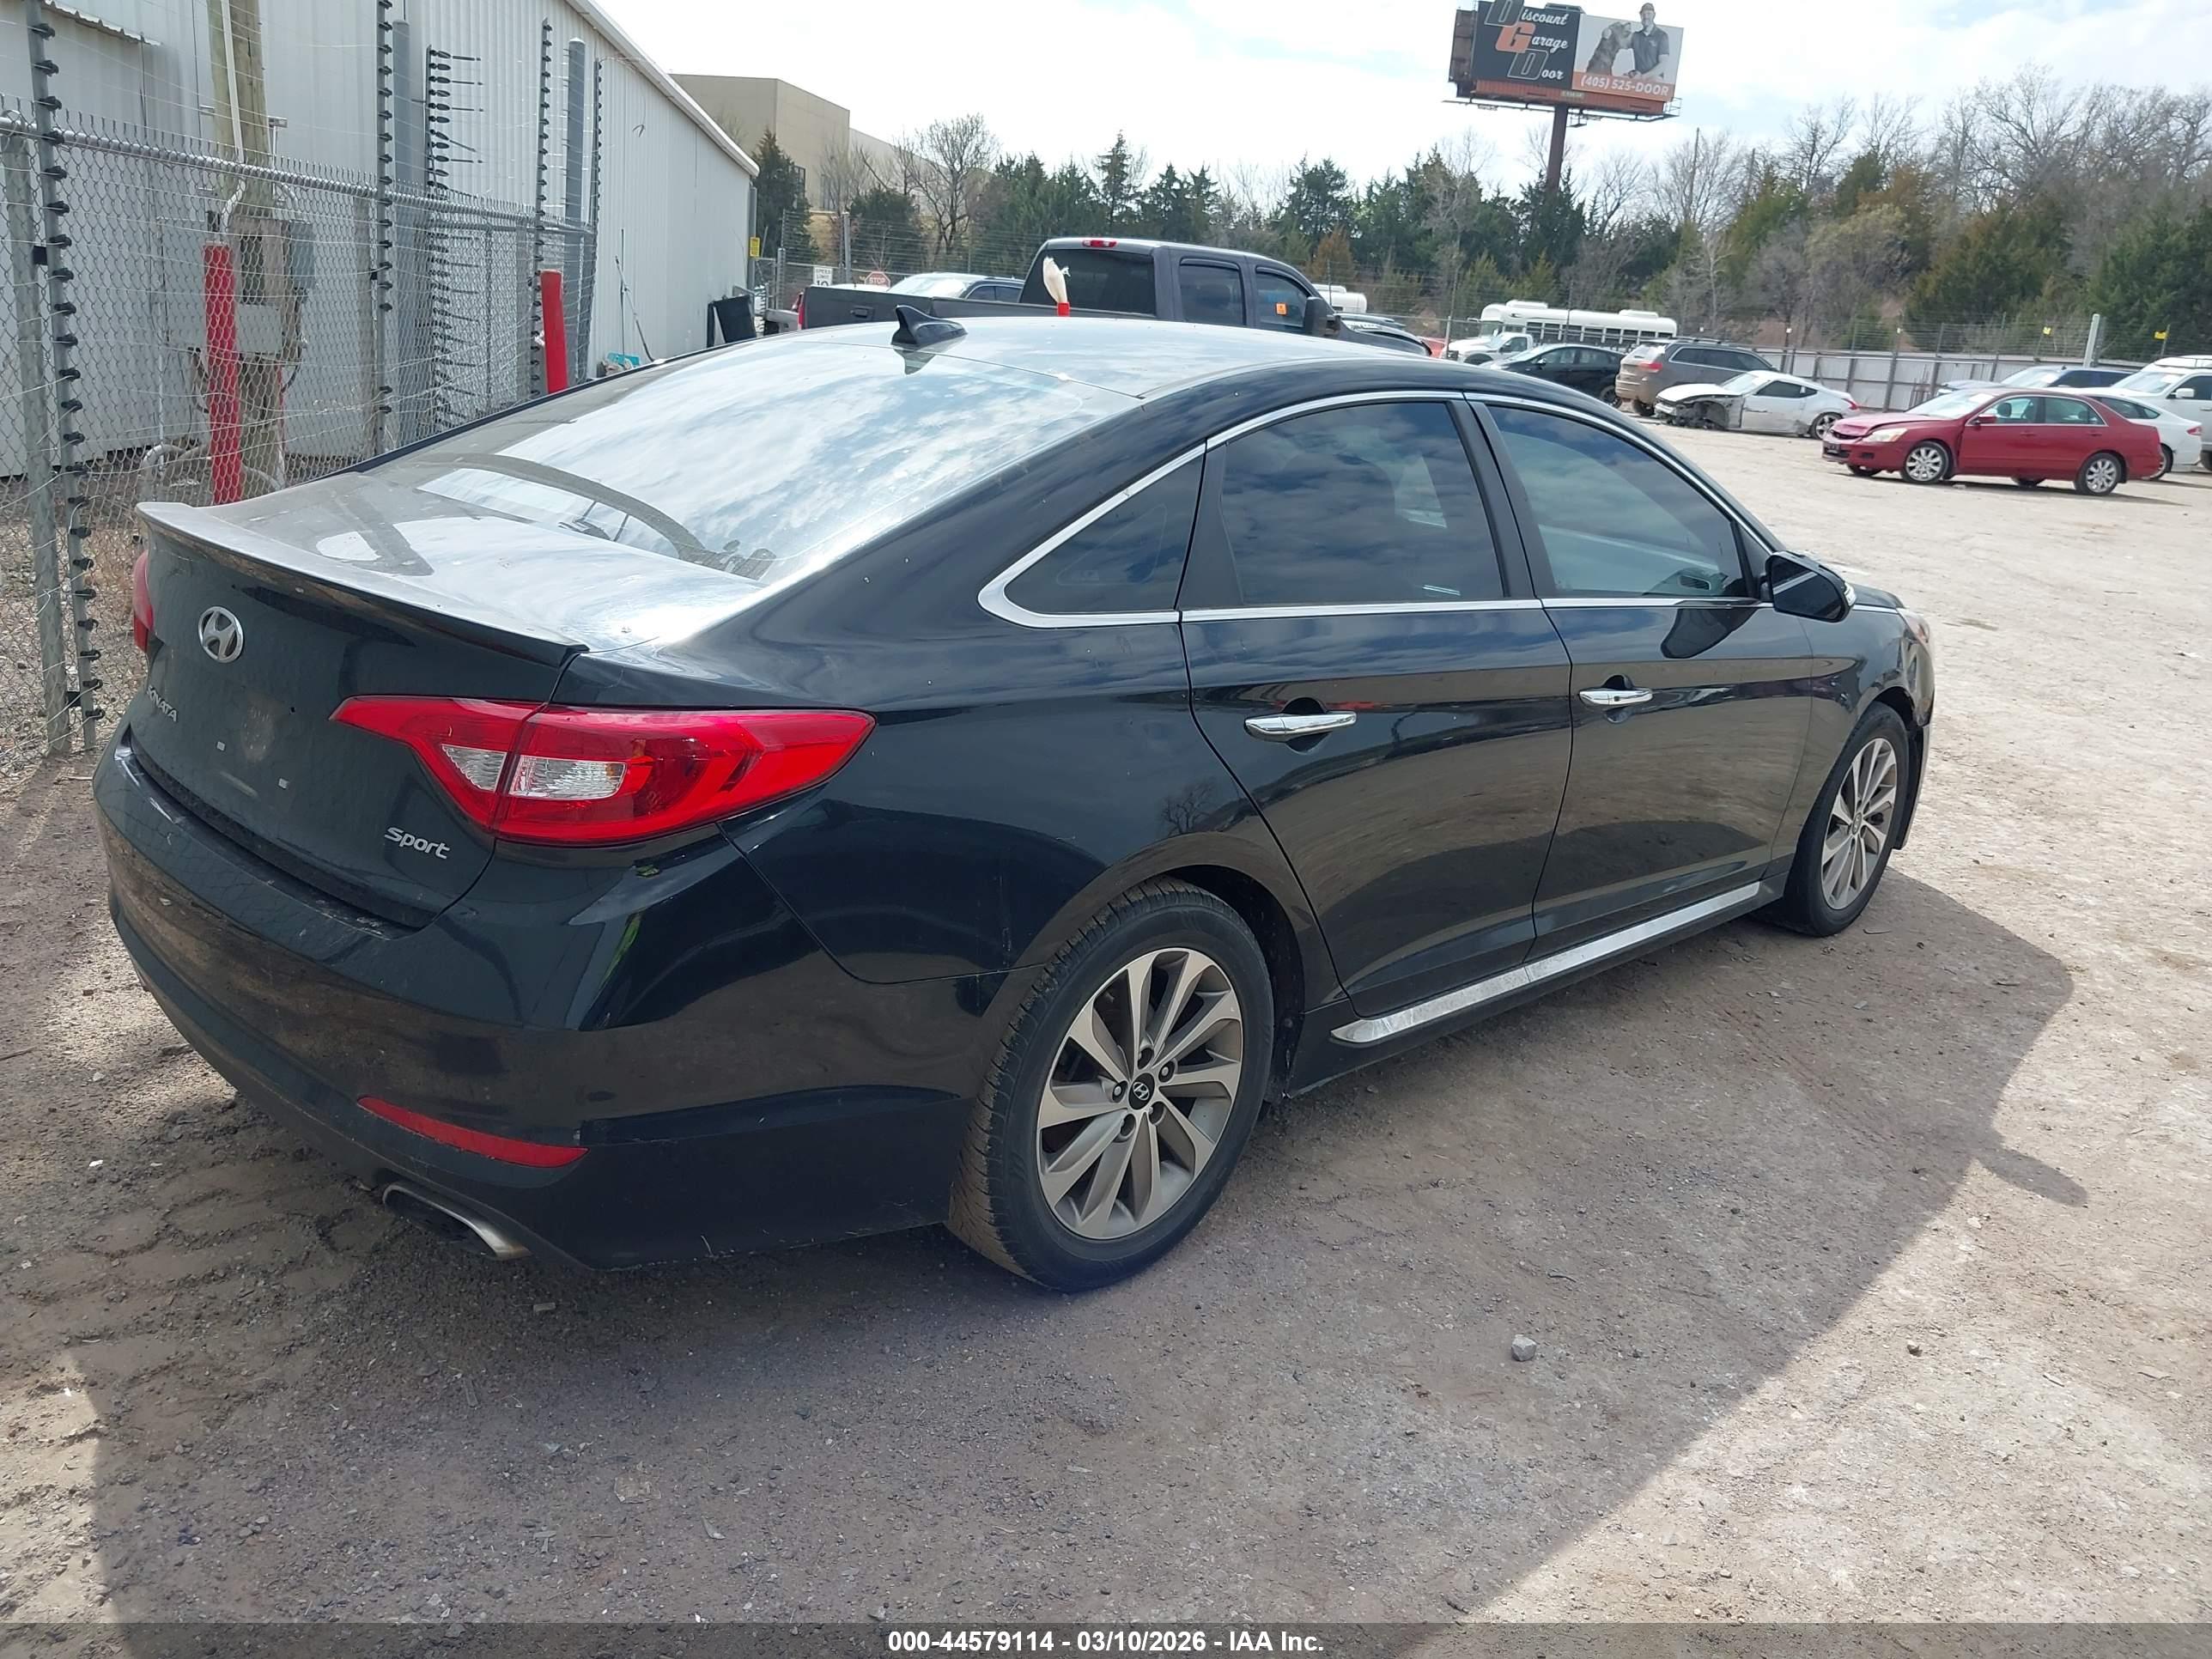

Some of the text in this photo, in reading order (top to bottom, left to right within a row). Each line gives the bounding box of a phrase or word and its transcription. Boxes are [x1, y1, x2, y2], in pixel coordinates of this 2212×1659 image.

[1495, 21, 1569, 53] Garage
[1507, 48, 1564, 80] Door
[1581, 75, 1669, 96] (405) 525-DOOR
[146, 684, 177, 722] SONATA
[384, 827, 451, 860] Sport
